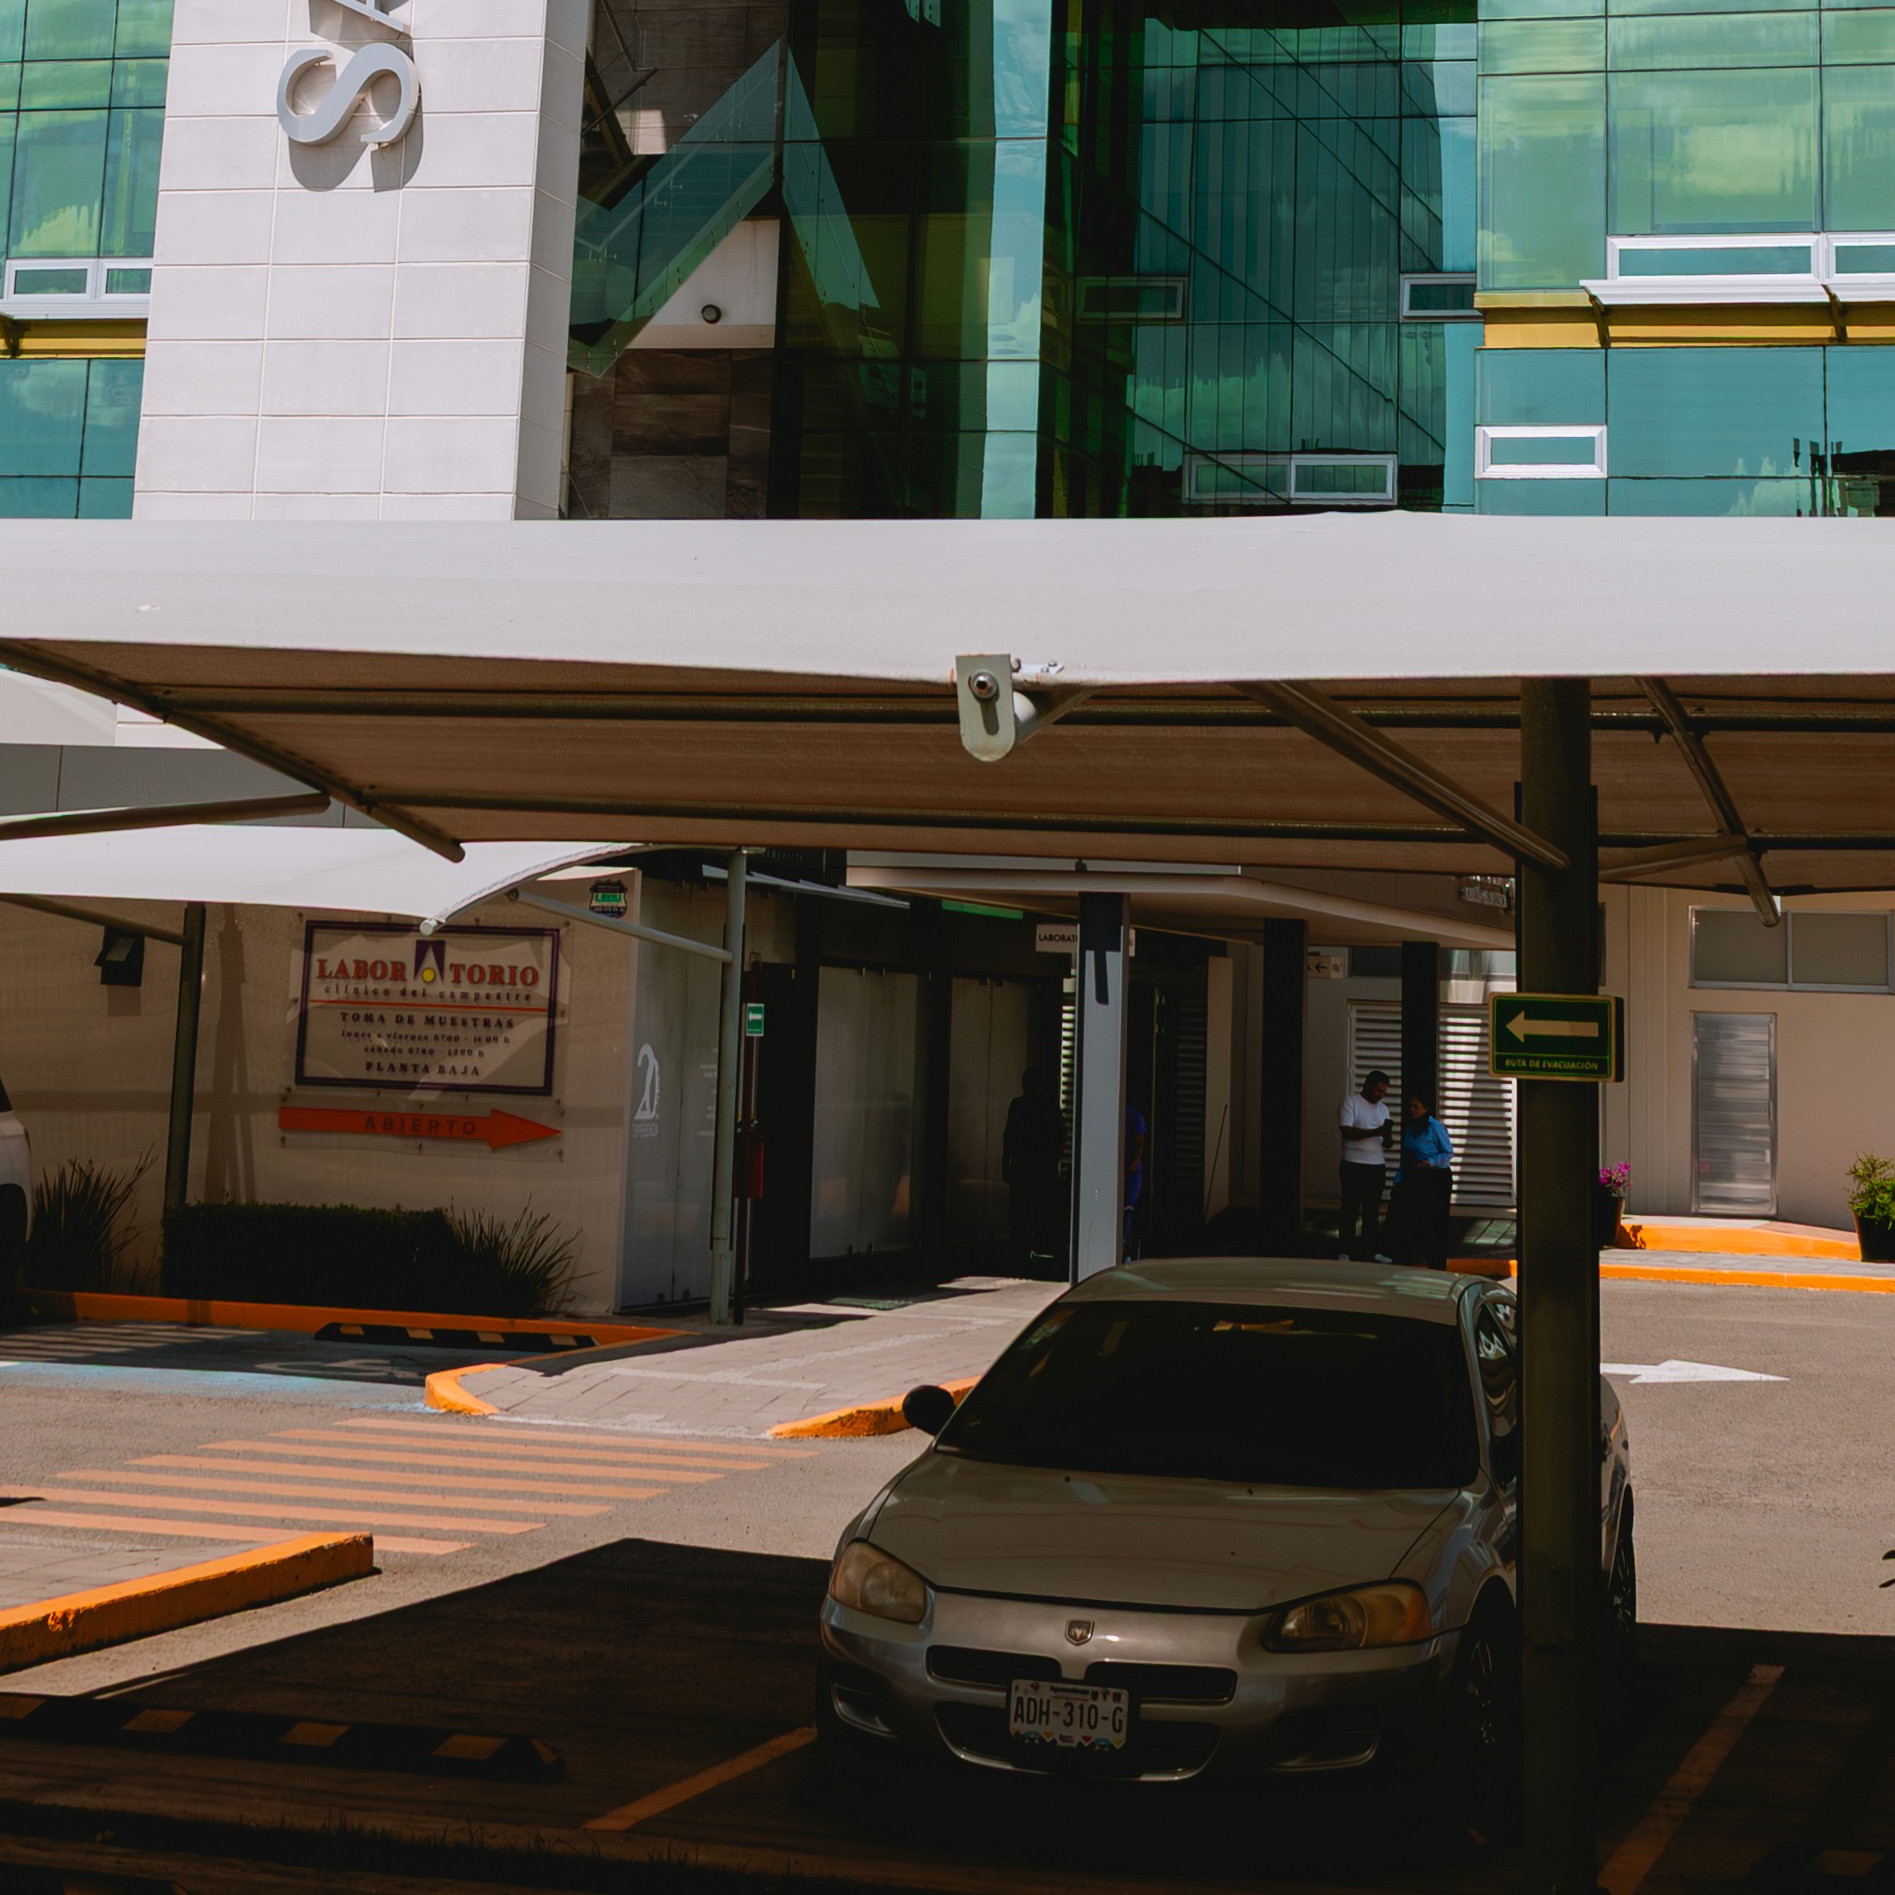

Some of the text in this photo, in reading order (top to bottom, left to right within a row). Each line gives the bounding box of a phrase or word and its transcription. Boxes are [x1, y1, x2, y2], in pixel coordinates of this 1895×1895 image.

[439, 989, 532, 1002] campestre
[339, 1011, 515, 1028] TOMA DE MUESTRAS
[365, 1061, 481, 1076] PLANTA BAJA
[1529, 1059, 1540, 1069] DE
[363, 1116, 477, 1135] ABIERTO
[1013, 1695, 1124, 1734] ADH-310-G
